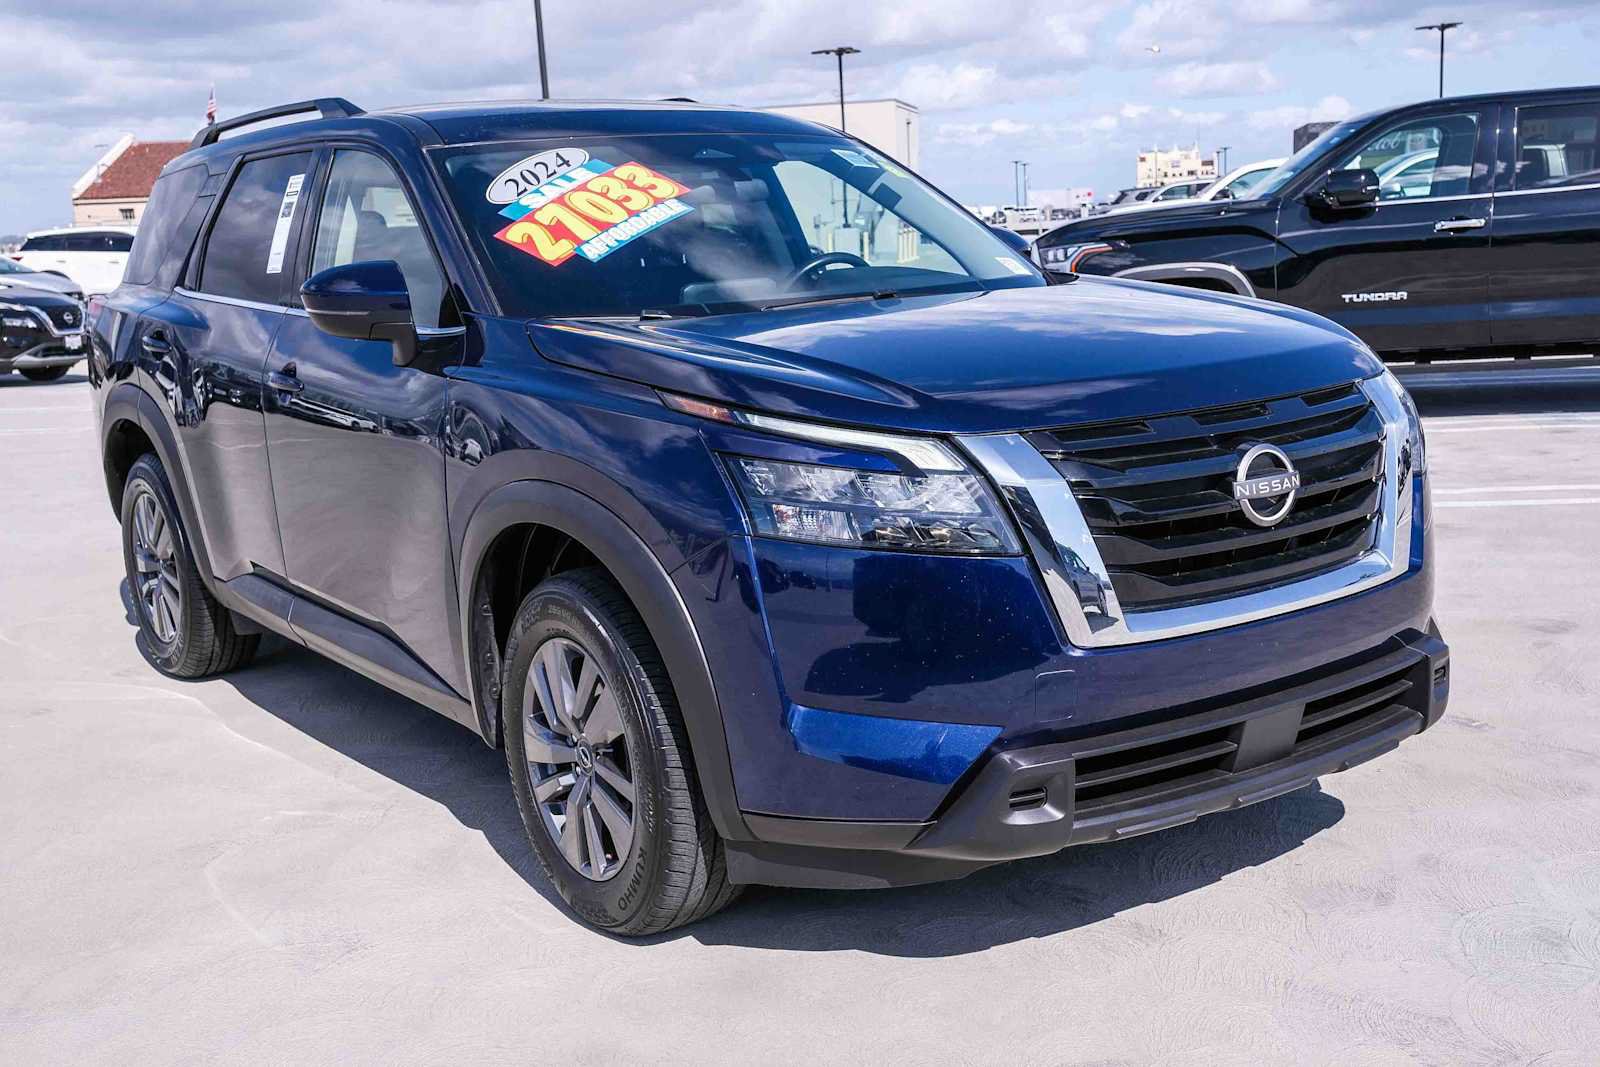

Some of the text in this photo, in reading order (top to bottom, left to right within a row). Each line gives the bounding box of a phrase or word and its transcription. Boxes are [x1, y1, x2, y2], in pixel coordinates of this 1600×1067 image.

[504, 152, 572, 198] 2024
[518, 167, 600, 208] SALE
[505, 164, 679, 261] 27033
[581, 199, 688, 259] AFFORDABLE
[1341, 291, 1408, 303] TUNDRA
[1236, 475, 1300, 496] NISSAN
[617, 845, 648, 912] KUMHO
